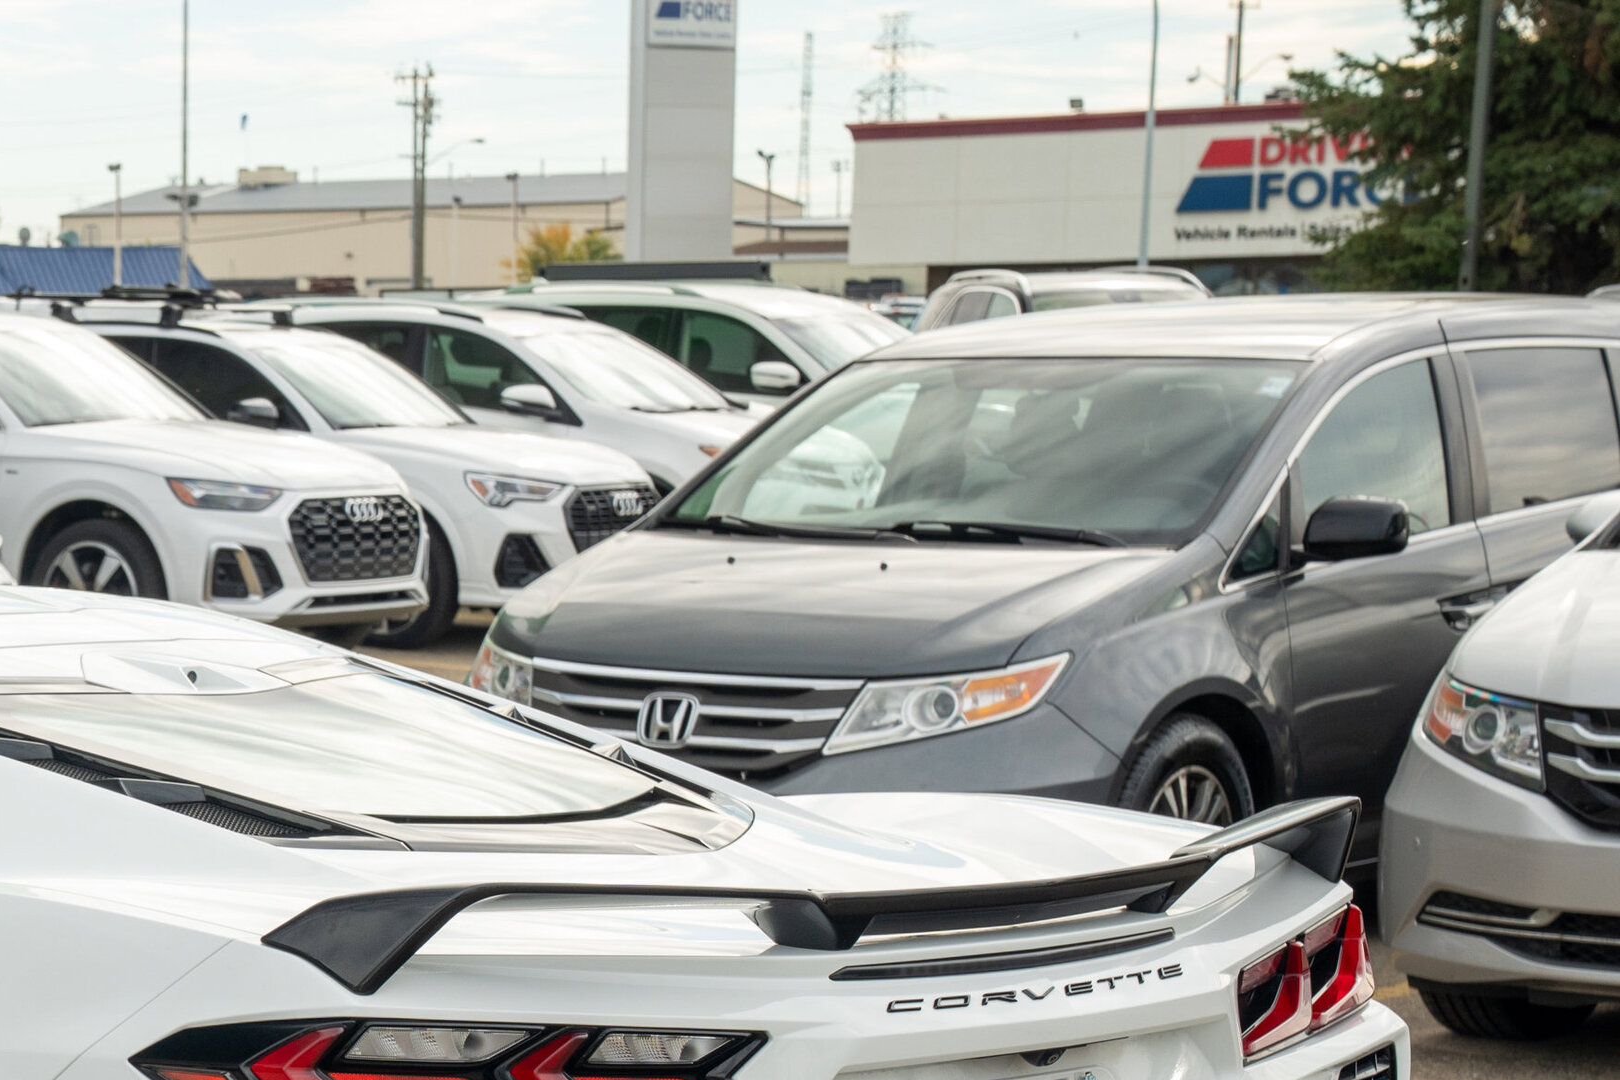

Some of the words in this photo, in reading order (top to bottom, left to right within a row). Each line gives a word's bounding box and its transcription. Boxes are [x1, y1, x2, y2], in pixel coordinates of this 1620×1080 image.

[1174, 227, 1230, 241] Vehicle
[1237, 224, 1297, 239] Rentals
[886, 963, 1184, 1014] CORVETTE
